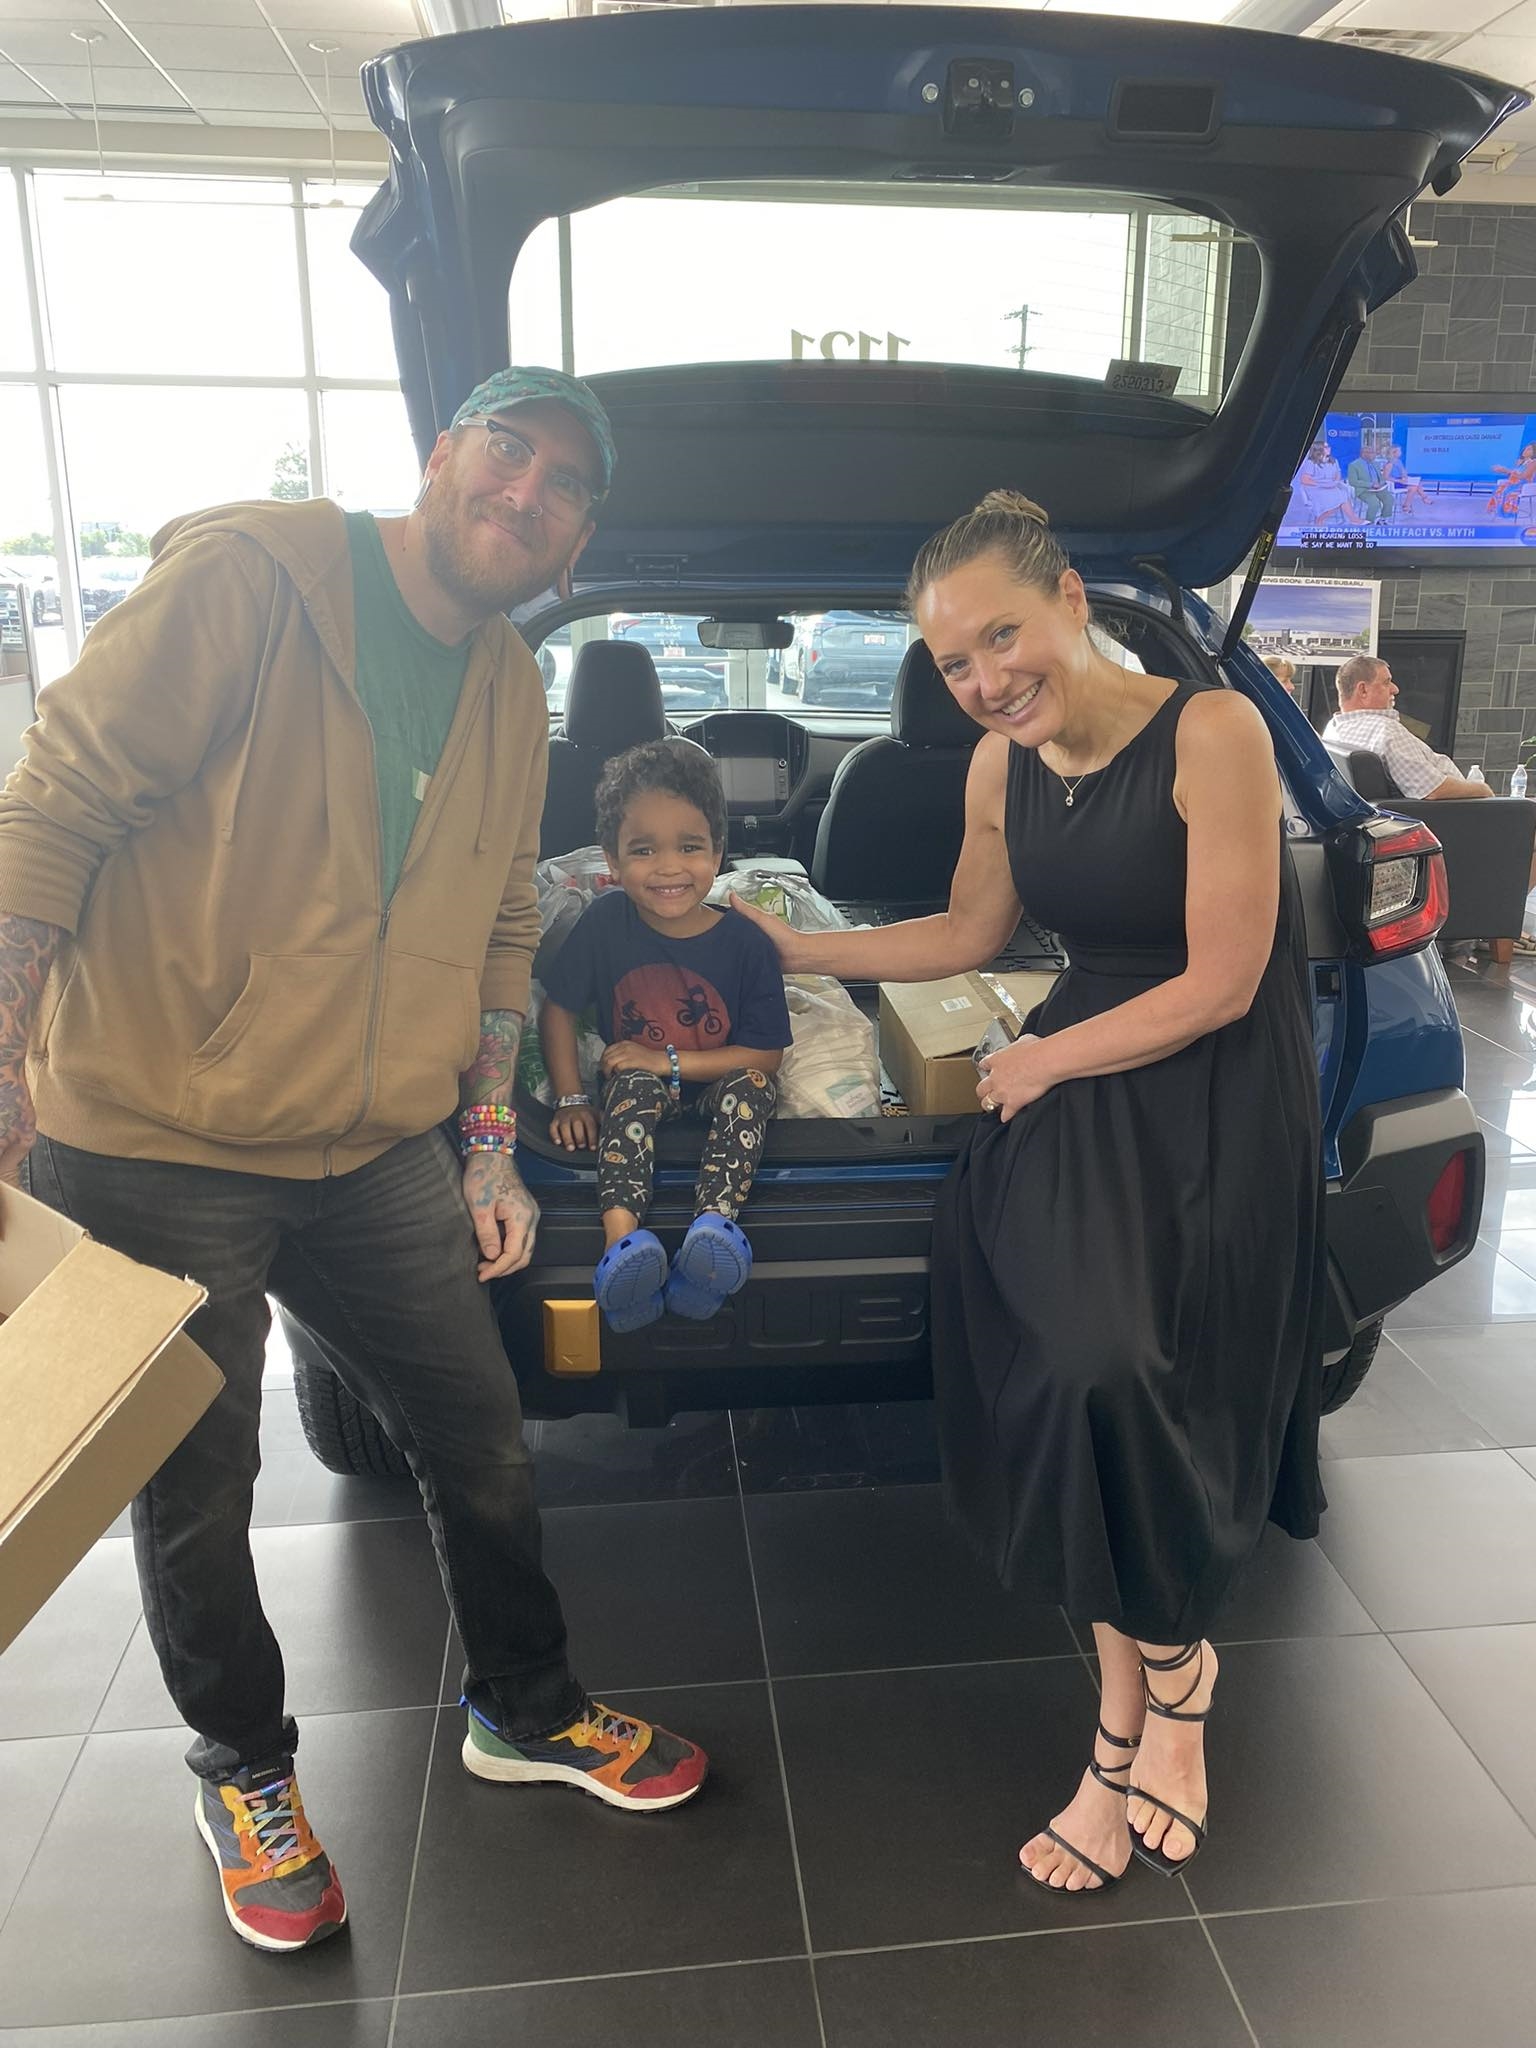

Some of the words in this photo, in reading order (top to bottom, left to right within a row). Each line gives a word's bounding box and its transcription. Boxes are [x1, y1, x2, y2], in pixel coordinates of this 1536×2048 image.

[1401, 527, 1427, 537] FACT
[1429, 527, 1445, 537] VS.
[1447, 527, 1475, 537] MYTH
